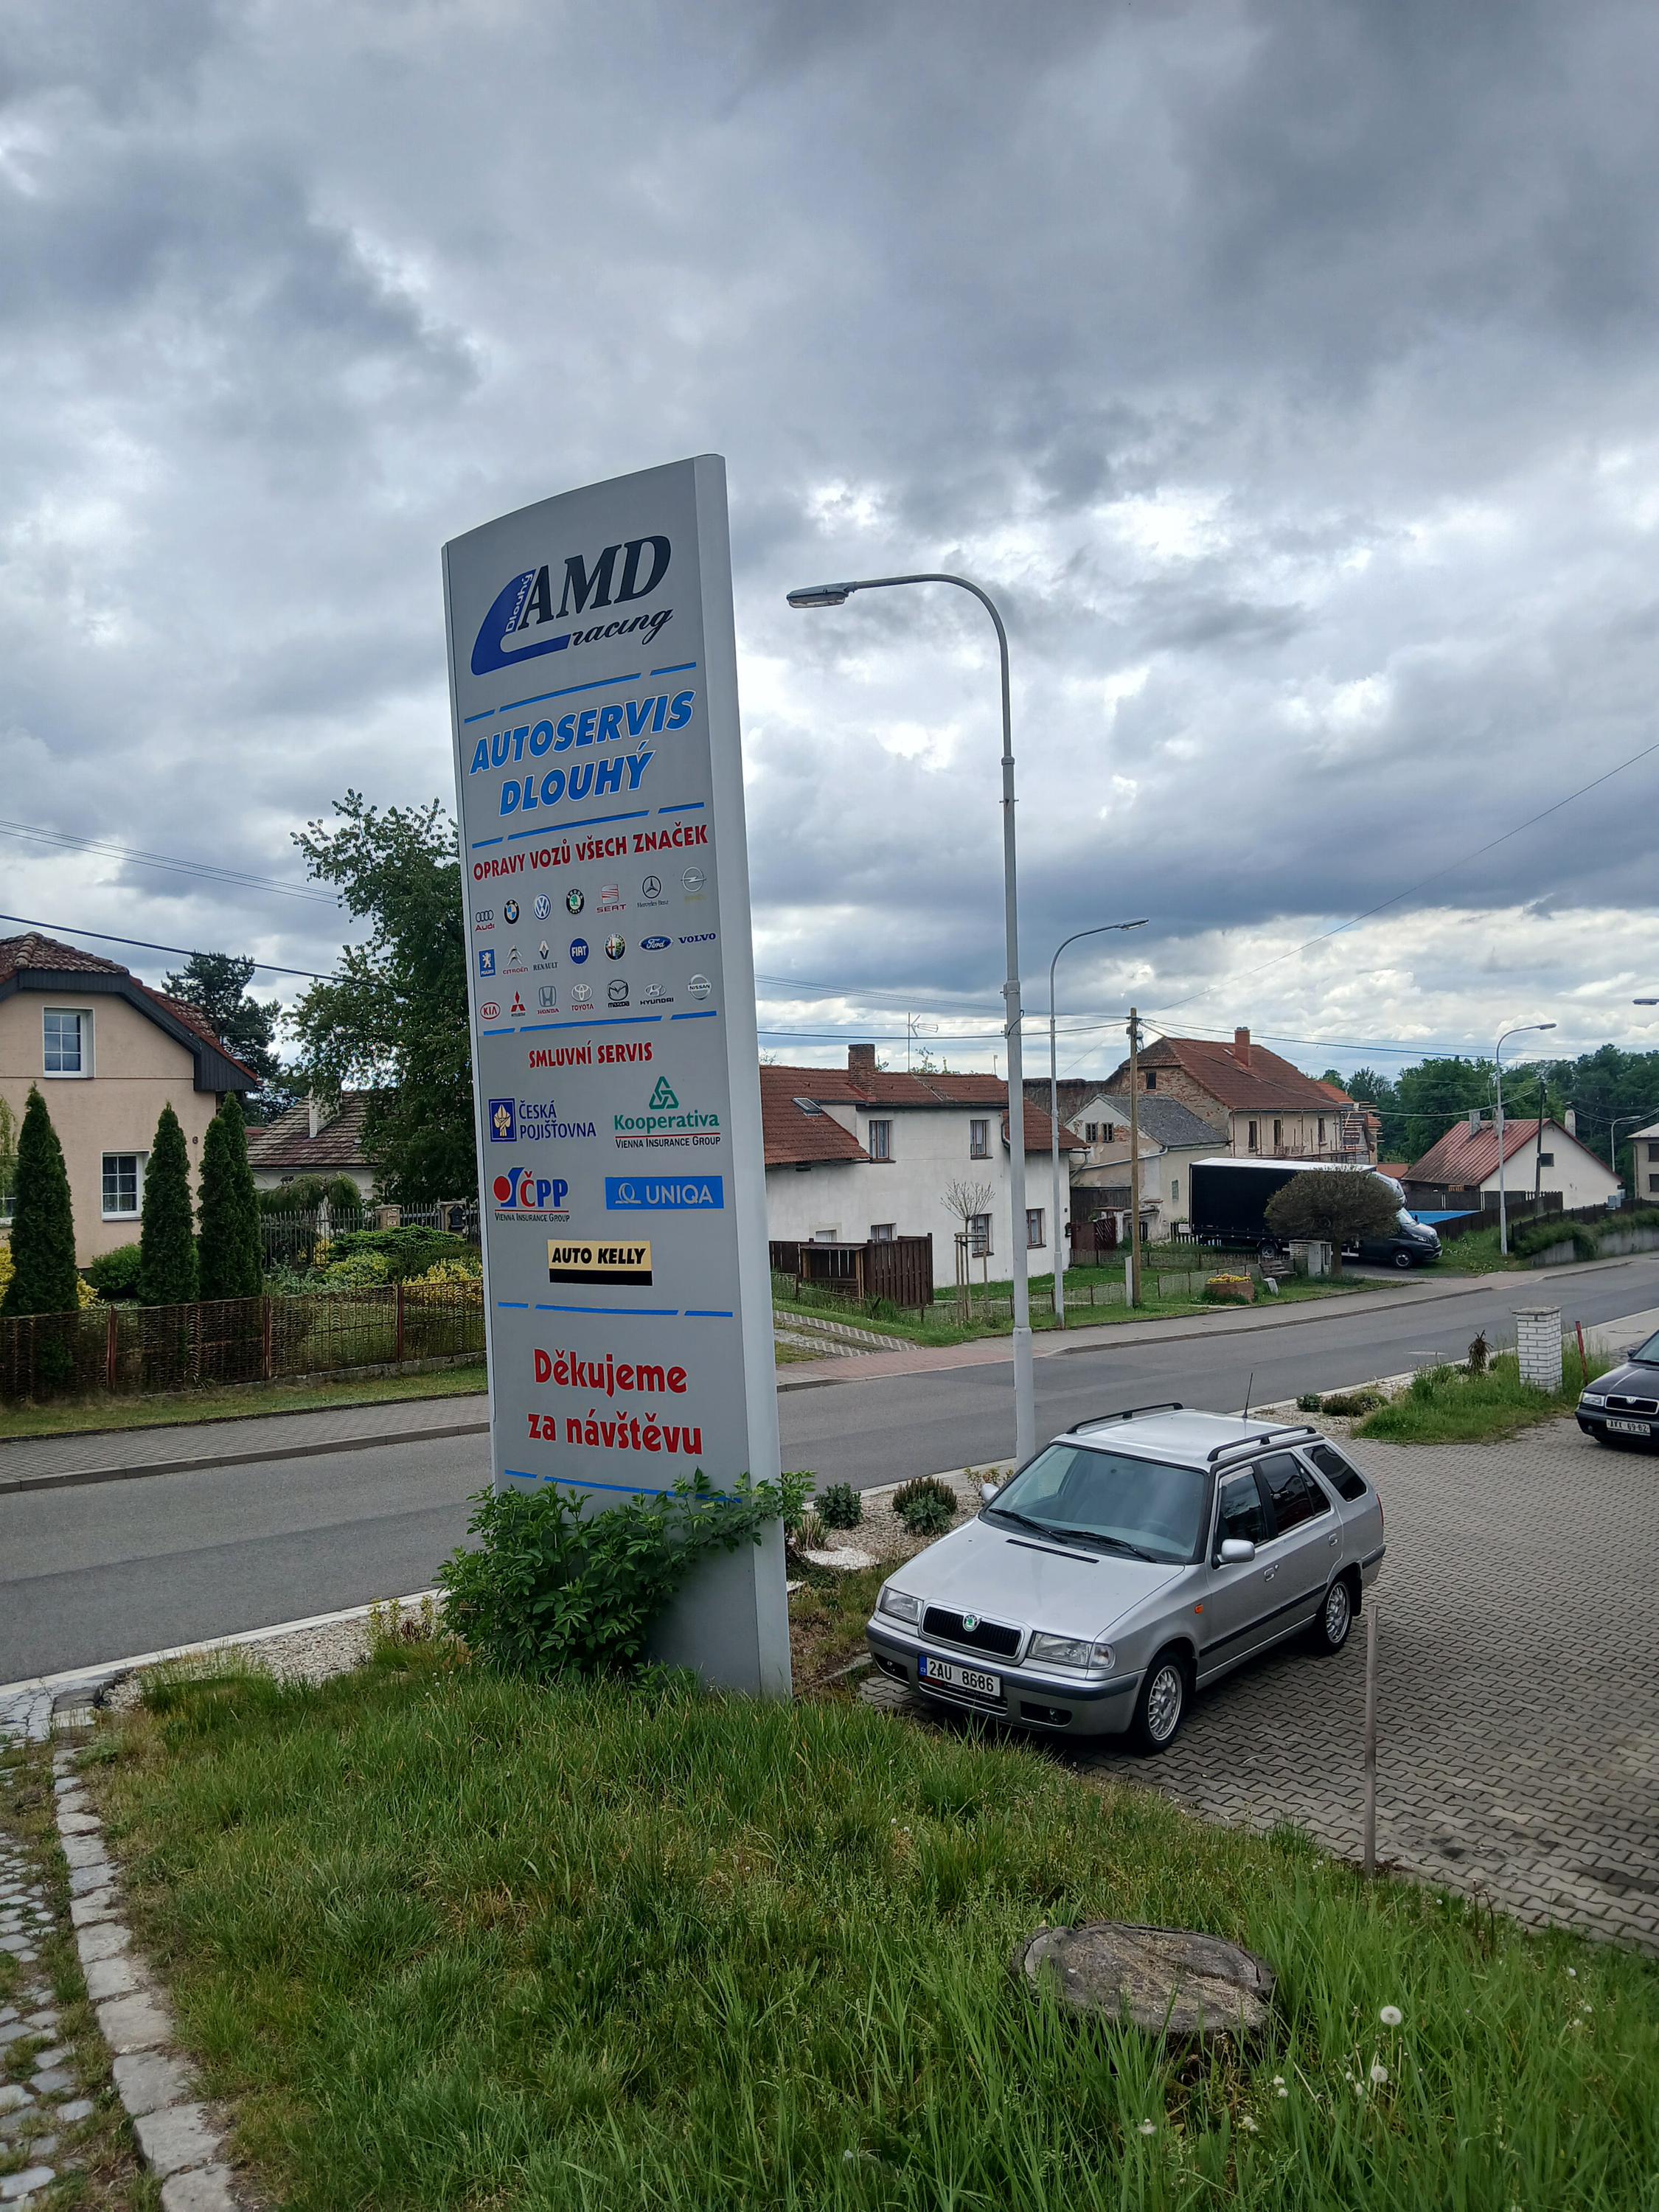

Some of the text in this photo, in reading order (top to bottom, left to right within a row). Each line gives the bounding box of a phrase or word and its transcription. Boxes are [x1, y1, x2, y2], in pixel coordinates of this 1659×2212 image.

[518, 535, 672, 630] AMD
[571, 609, 673, 645] racing
[468, 690, 696, 775] AUTOSERVIS
[499, 740, 656, 816] DLOUHÝ
[473, 821, 709, 881] OPRAVY VOZŮ VŠECH ZNAČEK
[597, 903, 627, 914] SEAT
[475, 922, 495, 932] Audi
[646, 939, 666, 949] Ford
[678, 932, 716, 945] VOLVO
[571, 945, 587, 957] FIAT
[533, 961, 558, 971] RENAULT
[484, 1006, 498, 1015] KIA
[571, 1003, 594, 1011] TOYOTA
[640, 997, 674, 1006] HYUNDAI
[529, 1040, 653, 1068] SMLUVNÍ SERVIS
[519, 1099, 557, 1120] ČESKÁ
[520, 1119, 597, 1141] POJIŠŤOVNA
[614, 1110, 720, 1134] Kooperativa
[520, 1171, 568, 1208] ČPP
[645, 1184, 714, 1204] UNIQA
[552, 1247, 646, 1265] AUTO KELLY
[533, 1348, 688, 1398] Děkujeme
[527, 1408, 703, 1455] za návštěvu
[929, 1660, 952, 1680] 2AU
[961, 1670, 994, 1692] 8686
